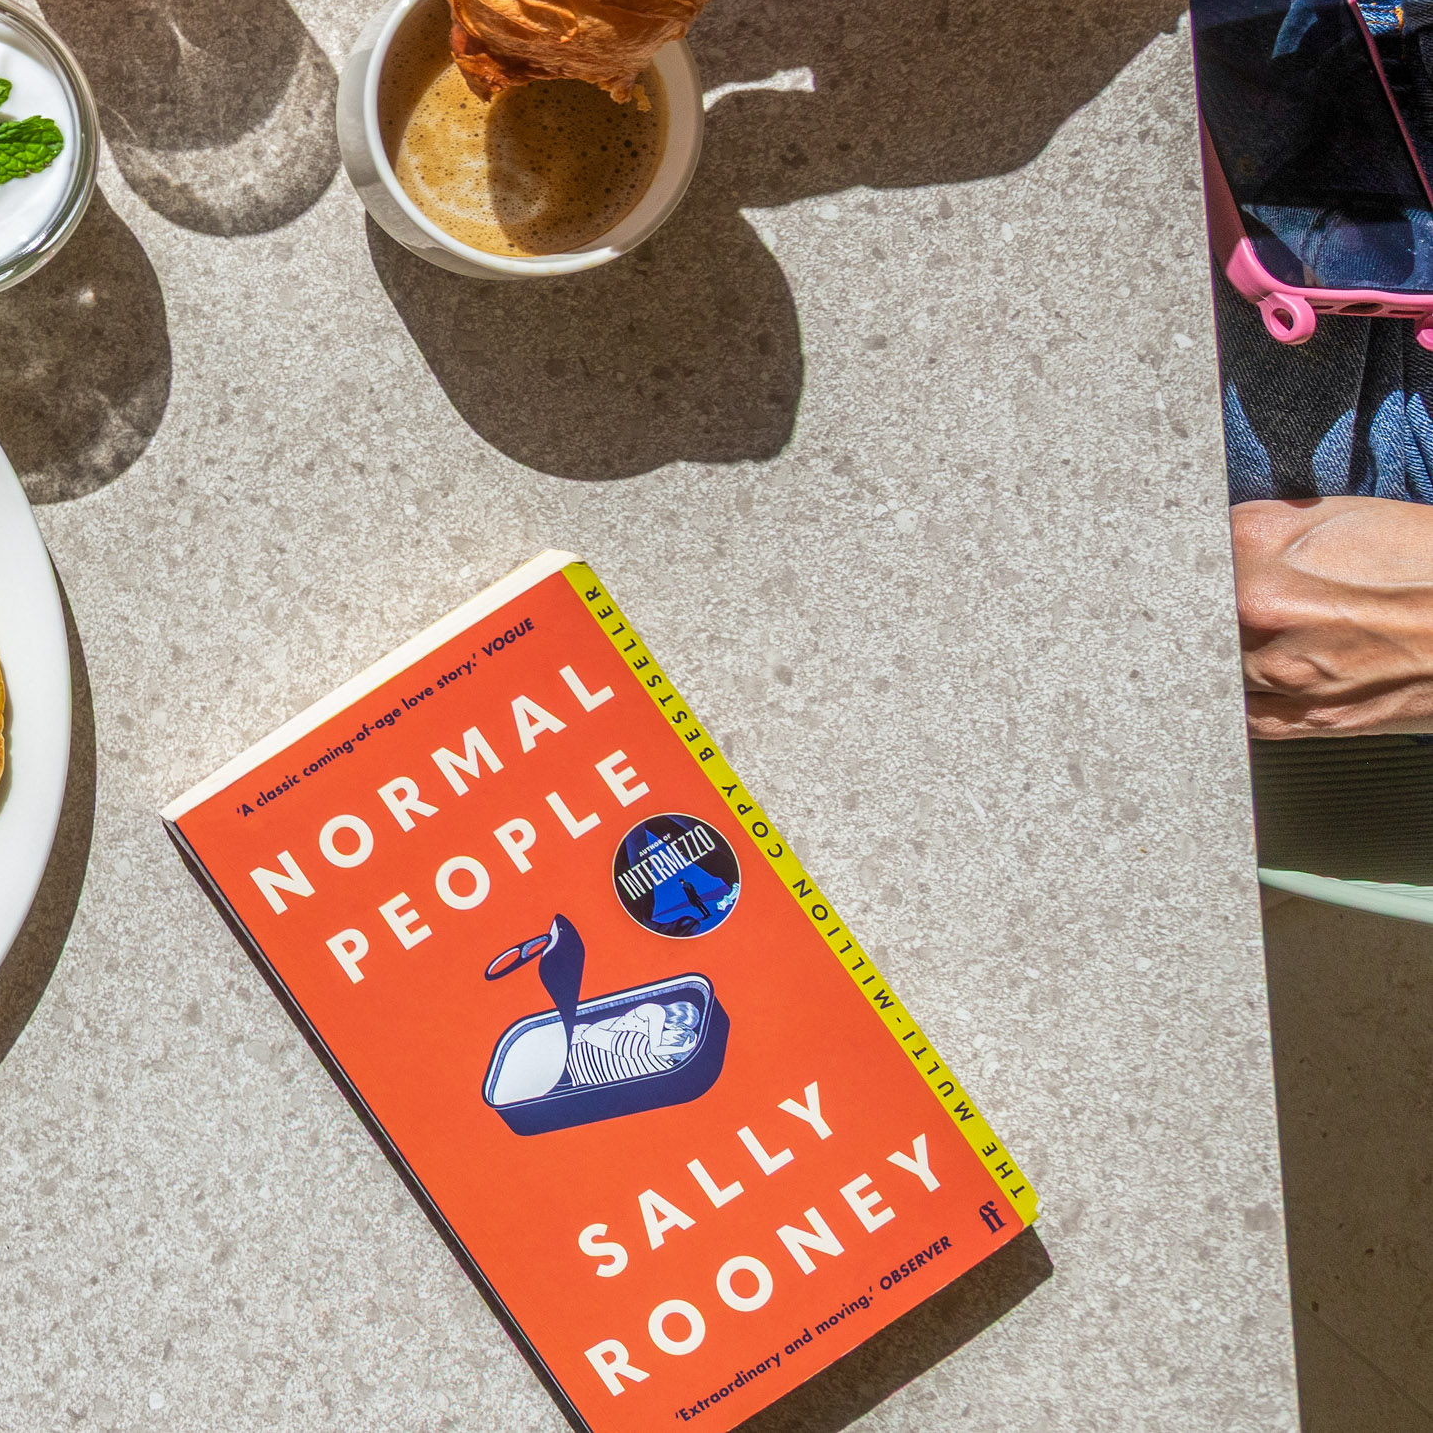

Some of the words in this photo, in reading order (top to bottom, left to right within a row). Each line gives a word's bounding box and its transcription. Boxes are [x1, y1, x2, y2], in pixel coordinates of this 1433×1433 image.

[256, 774, 301, 807] classic
[302, 706, 402, 777] coming-of-age
[401, 686, 434, 710] love
[481, 617, 535, 658] VOGUE
[585, 585, 715, 762] BESTSELLER
[249, 664, 615, 915] NORMAL
[326, 749, 651, 985] PEOPLE
[618, 824, 716, 901] INTERMEZZO
[638, 839, 664, 858] AUTHOR
[721, 783, 783, 858] COPY
[578, 1081, 833, 1278] SALLY
[982, 1142, 1025, 1199] THE
[585, 1133, 941, 1398] ROONEY
[784, 1328, 813, 1356] and
[879, 1235, 952, 1291] OBSERVER
